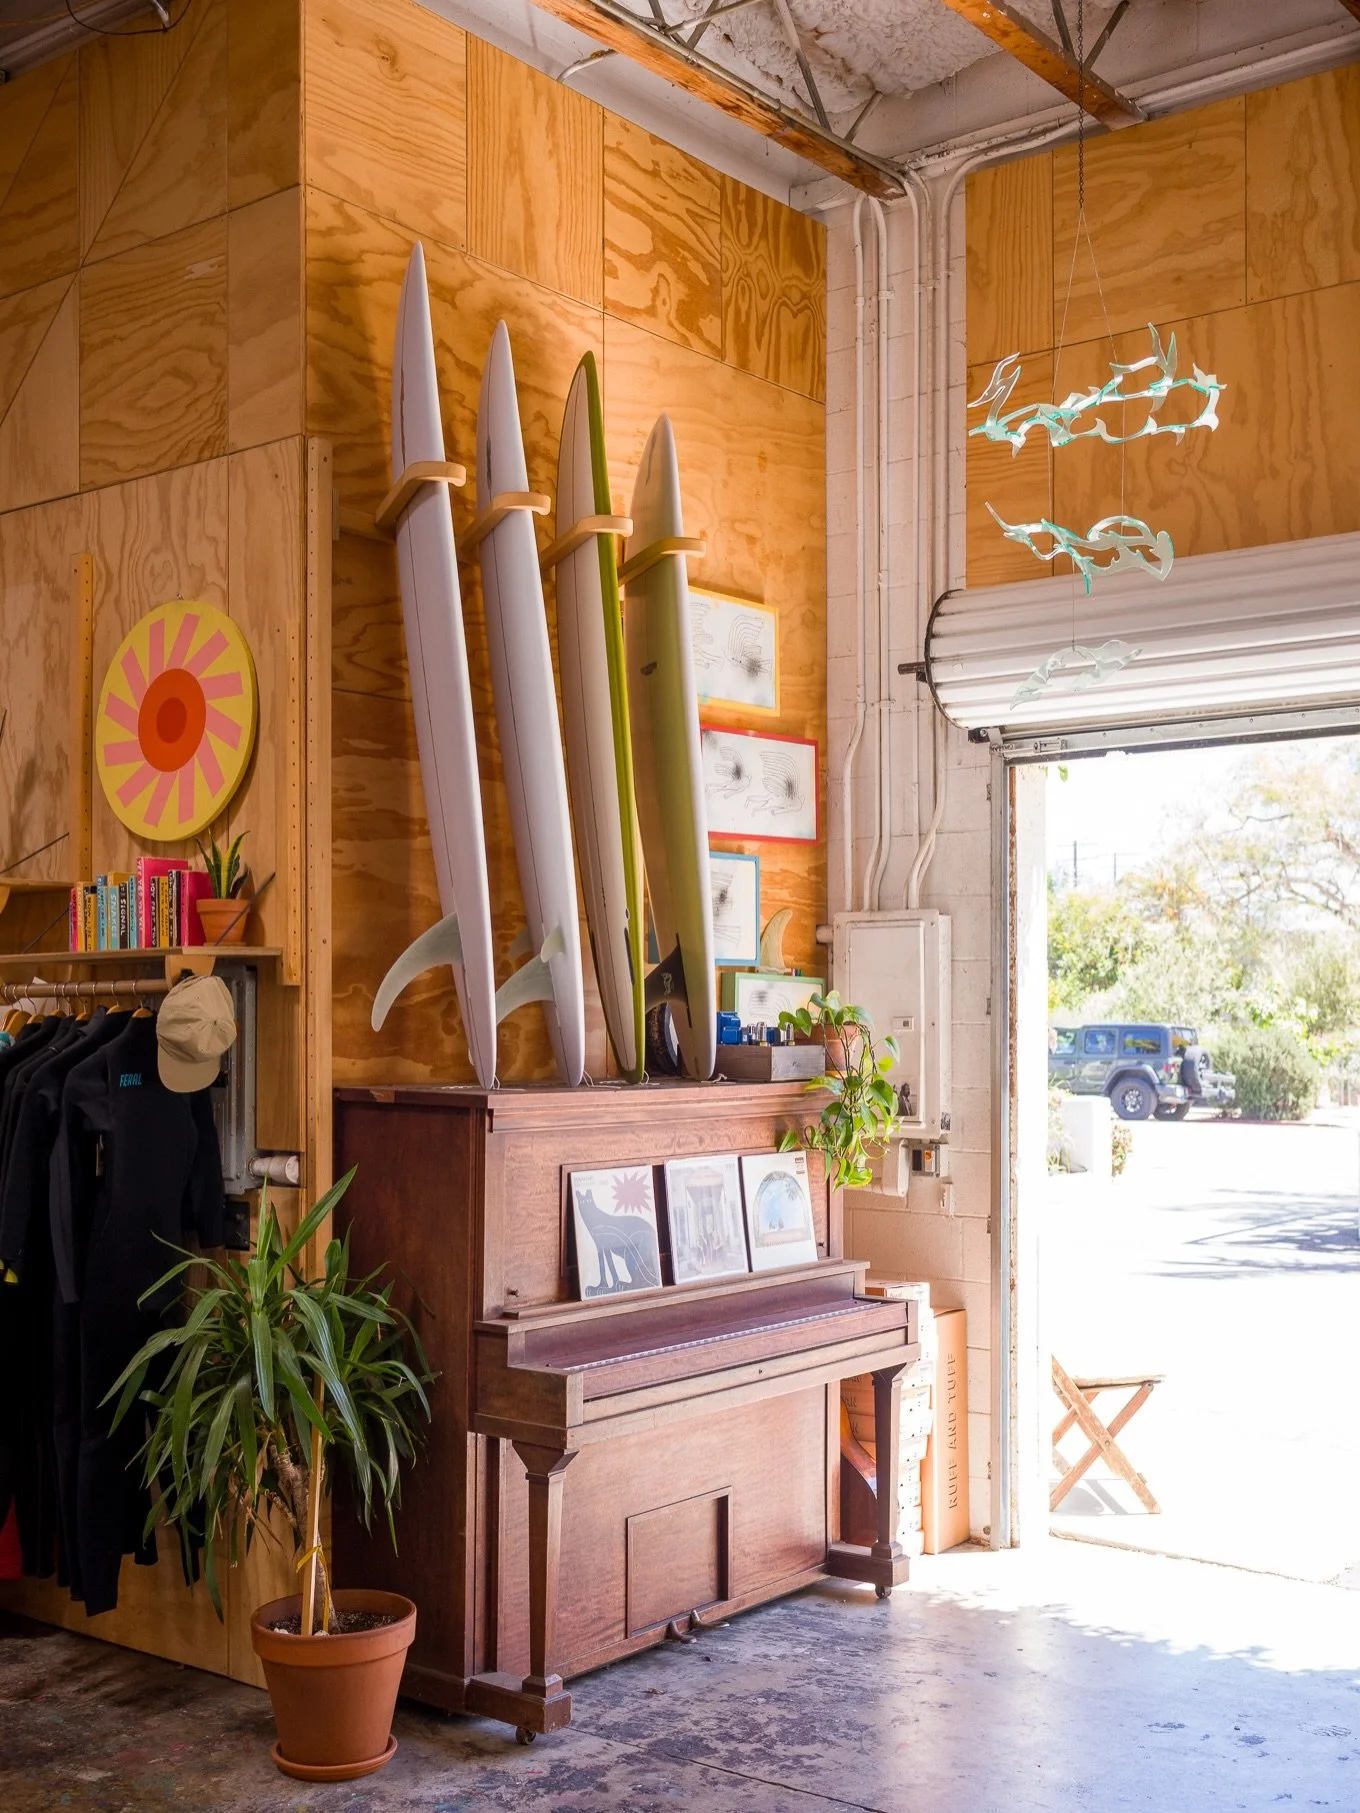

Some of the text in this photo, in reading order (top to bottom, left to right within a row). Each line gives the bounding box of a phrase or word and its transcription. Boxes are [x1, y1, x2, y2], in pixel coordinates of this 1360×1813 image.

[119, 1073, 142, 1087] FERAL
[946, 1353, 956, 1404] TUFF
[947, 1458, 958, 1510] RUFF
